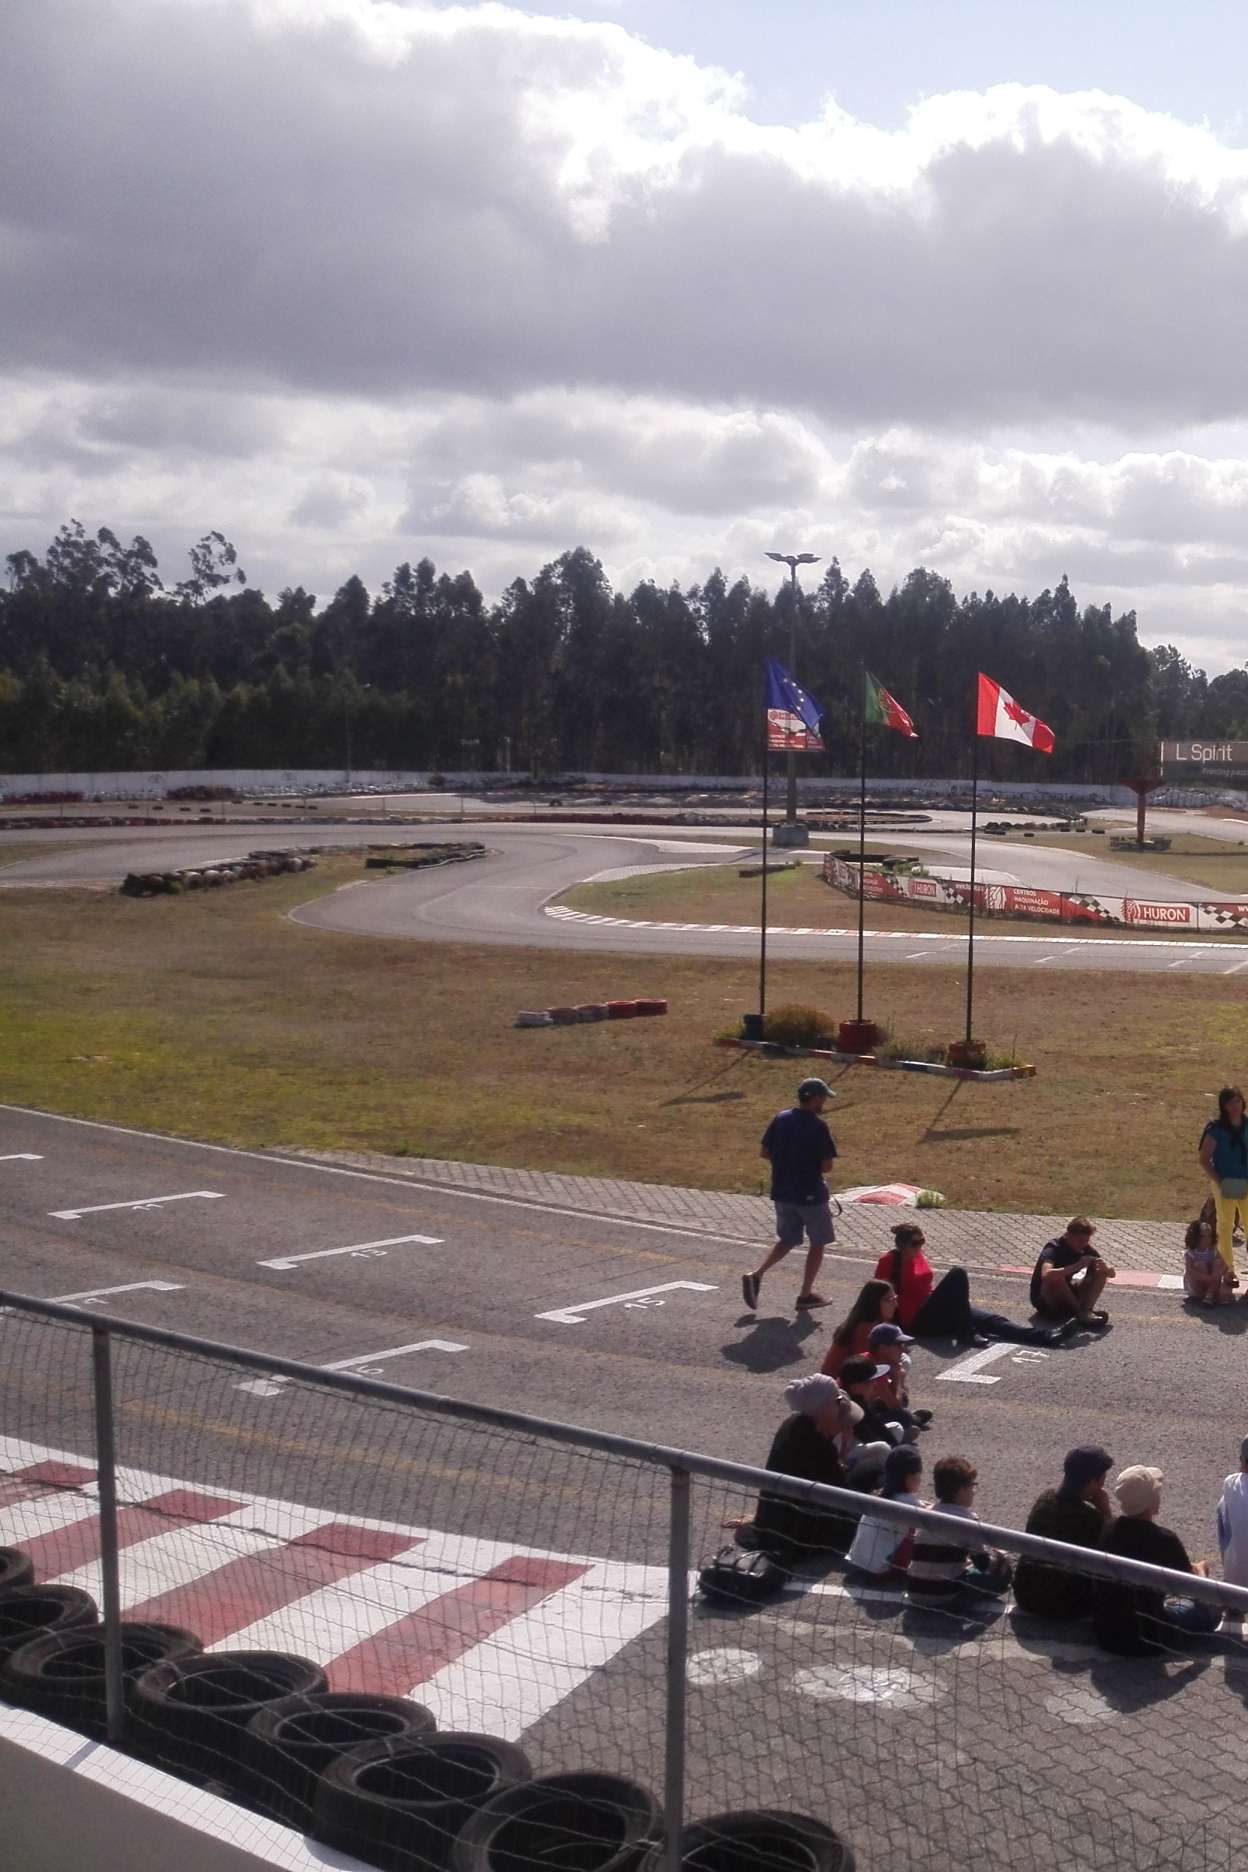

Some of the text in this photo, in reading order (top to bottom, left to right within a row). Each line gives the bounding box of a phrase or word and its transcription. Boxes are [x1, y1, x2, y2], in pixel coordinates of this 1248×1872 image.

[1191, 743, 1233, 764] Spirit
[1143, 906, 1186, 921] HURON
[351, 1249, 388, 1258] 13
[623, 1297, 666, 1309] 15
